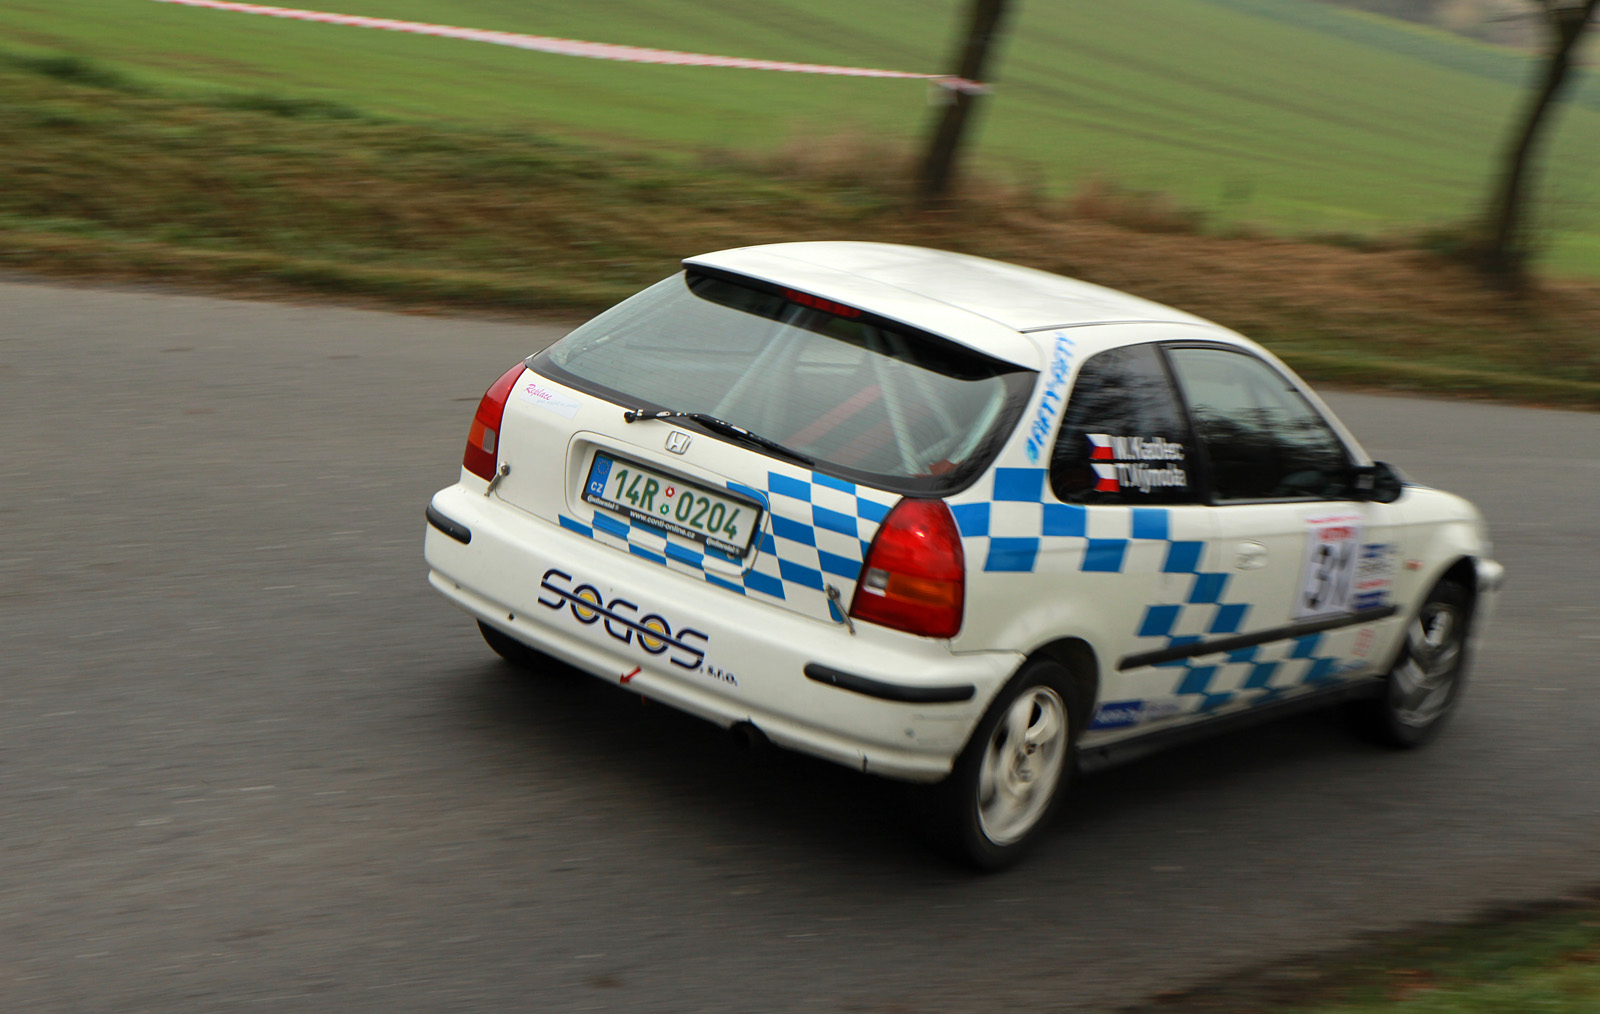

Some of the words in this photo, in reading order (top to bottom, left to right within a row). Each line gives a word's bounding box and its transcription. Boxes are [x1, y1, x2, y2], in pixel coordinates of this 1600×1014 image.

[524, 383, 553, 400] Replace
[590, 481, 604, 493] CZ
[615, 469, 660, 512] 14R
[675, 491, 741, 540] 0204
[629, 510, 696, 539] www.conti-online.cz
